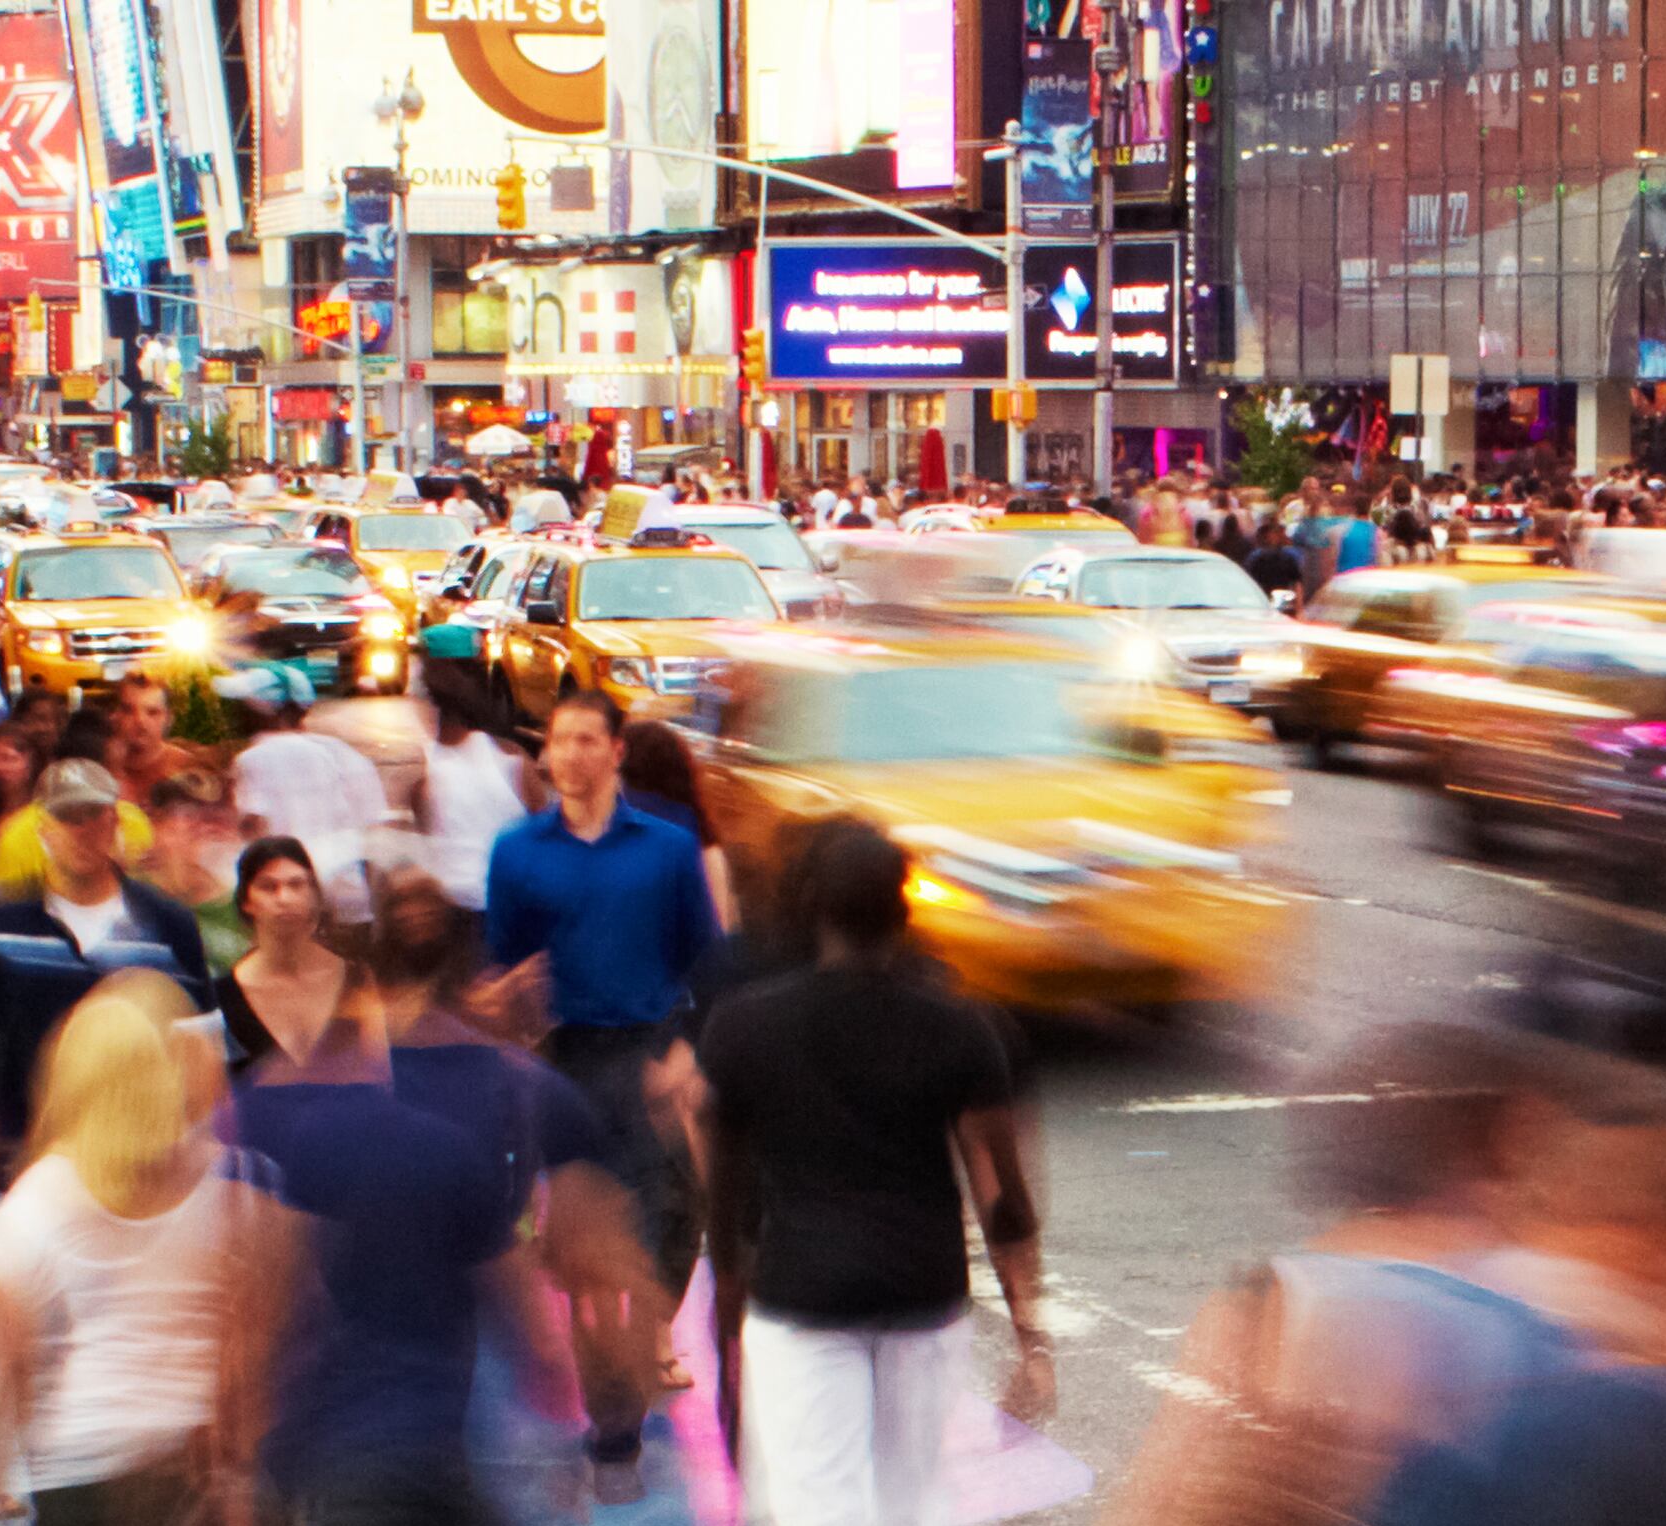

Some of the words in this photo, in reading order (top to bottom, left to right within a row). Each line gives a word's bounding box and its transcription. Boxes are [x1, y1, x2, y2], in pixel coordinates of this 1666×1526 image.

[1276, 88, 1327, 112] THE
[1354, 79, 1441, 103] FIRST
[1465, 62, 1628, 96] AVENGER
